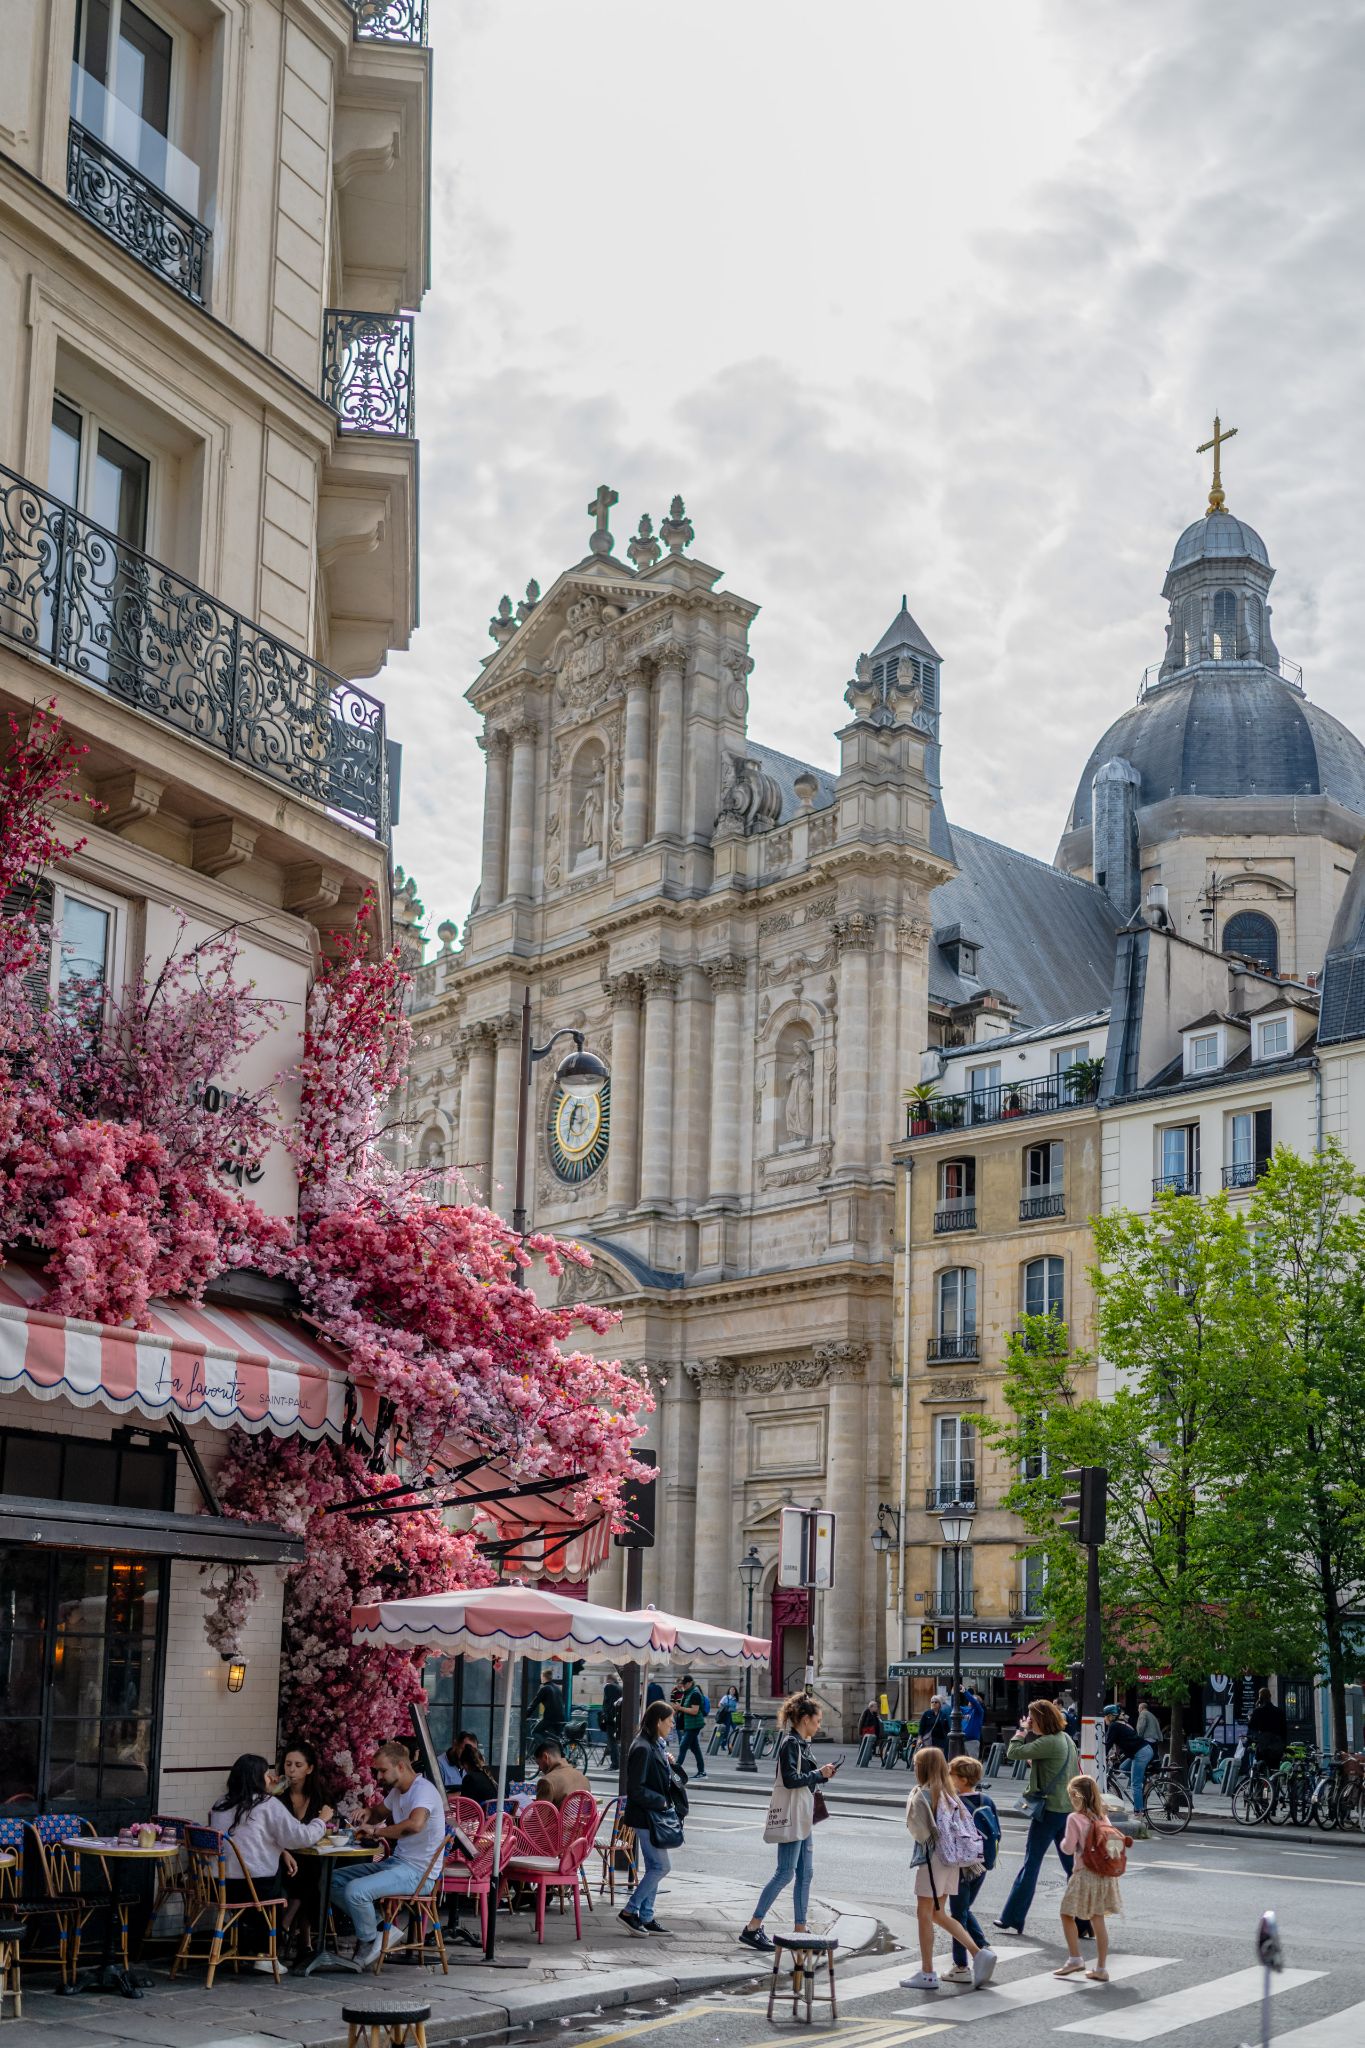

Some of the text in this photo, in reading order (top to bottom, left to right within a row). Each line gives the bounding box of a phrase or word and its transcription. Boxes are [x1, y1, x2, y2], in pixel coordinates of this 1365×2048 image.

[155, 1356, 311, 1410] La favorite SAINT-PAUL
[898, 1668, 918, 1676] PLATS
[927, 1668, 963, 1676] EMPORTR
[968, 1668, 980, 1676] TEL
